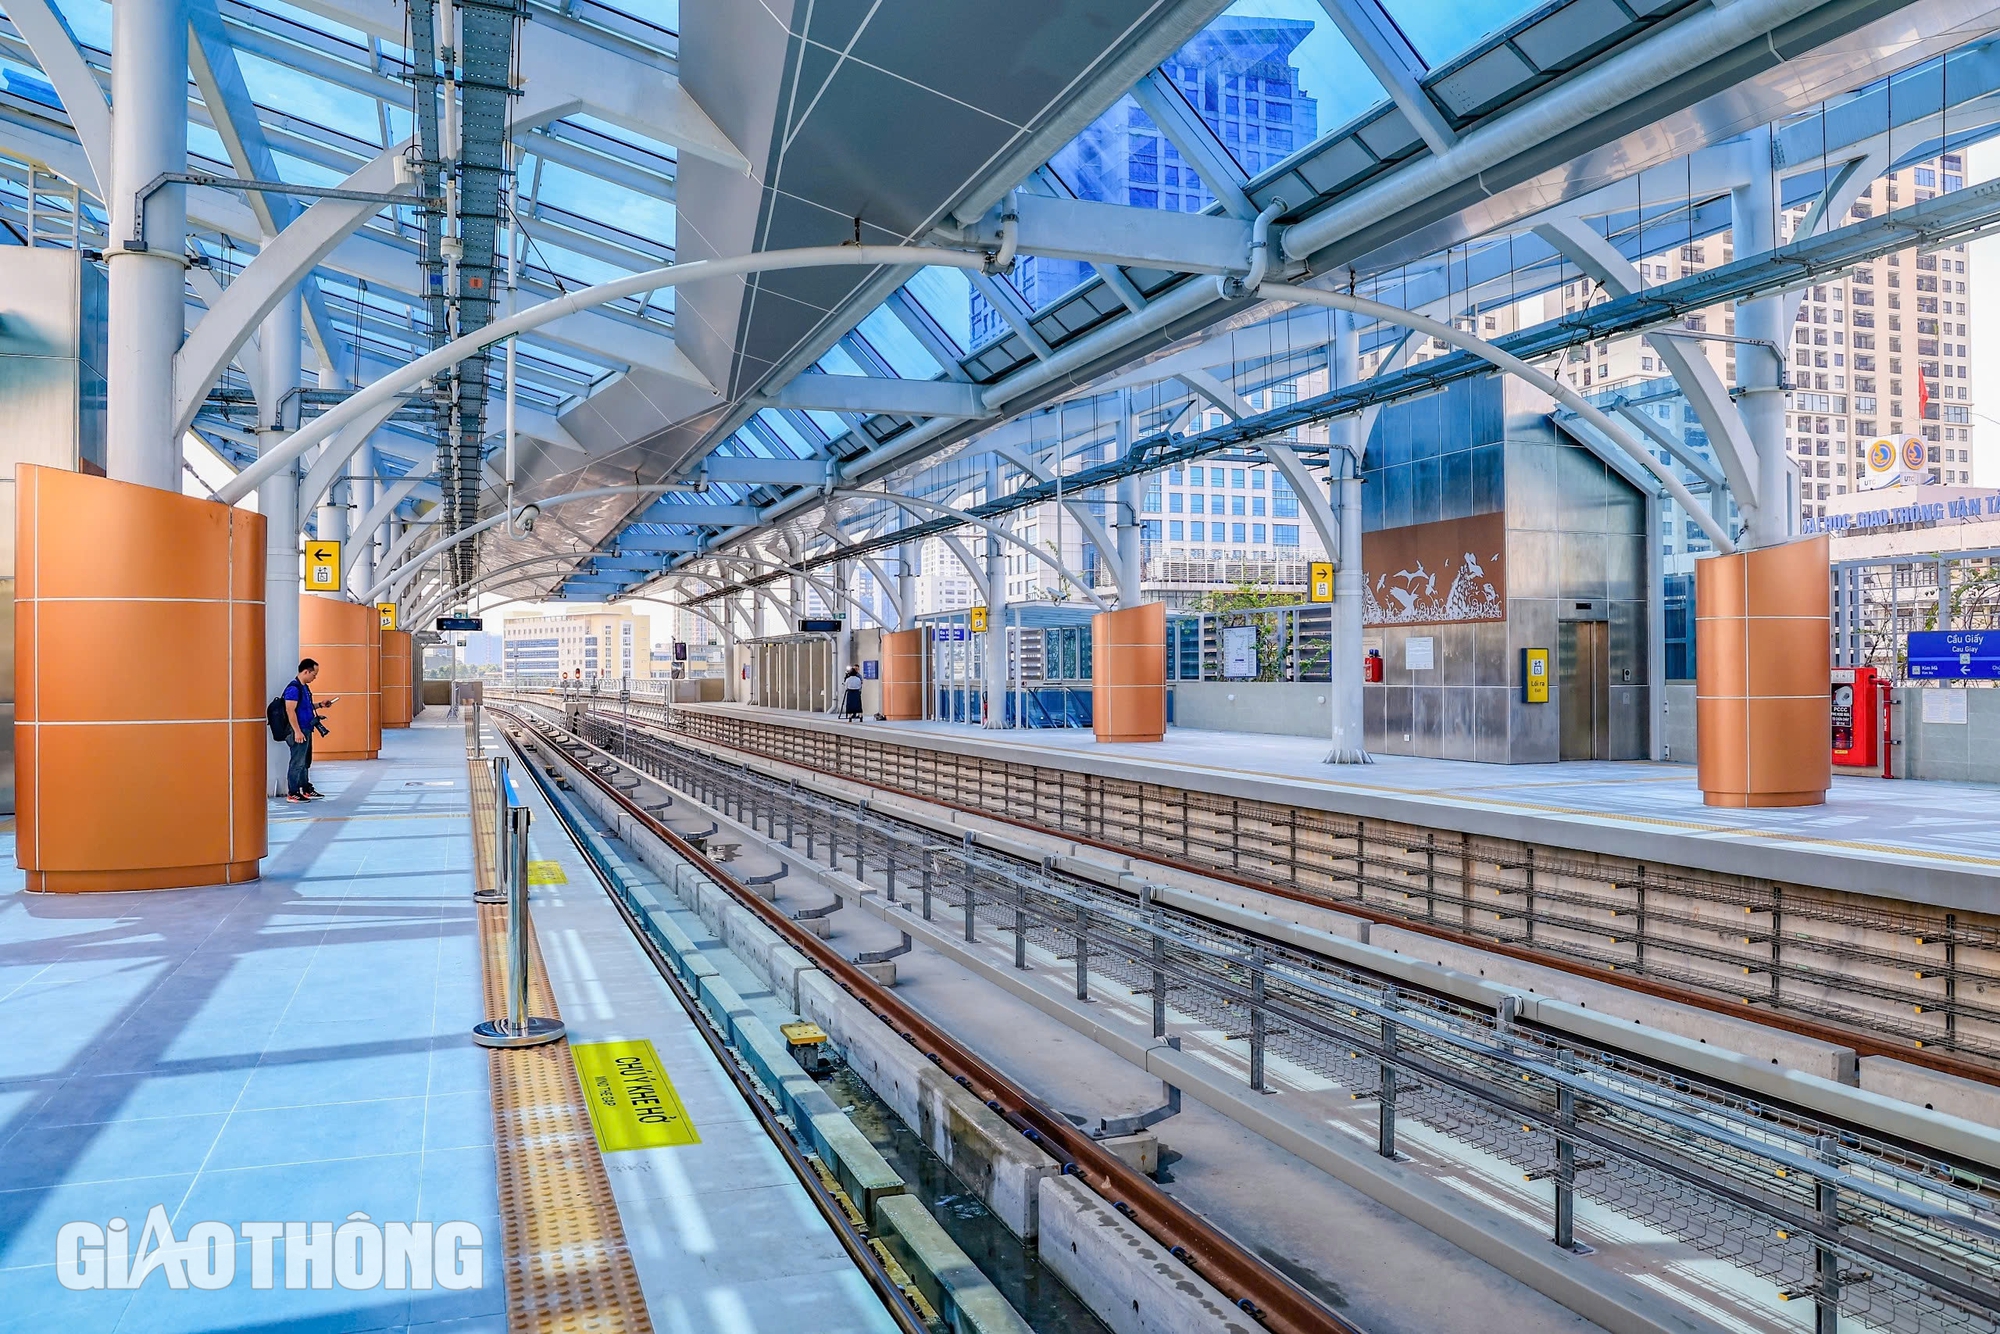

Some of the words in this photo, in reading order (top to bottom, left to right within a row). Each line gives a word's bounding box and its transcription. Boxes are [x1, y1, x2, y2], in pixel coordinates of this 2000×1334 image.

[1823, 513, 1851, 533] HỌC
[1856, 509, 1889, 528] GIAO
[1891, 502, 1944, 524] THÔNG
[1964, 645, 1979, 654] Giay
[615, 1057, 653, 1076] CHÚ
[626, 1084, 660, 1106] KHE
[635, 1106, 677, 1124] HỞ
